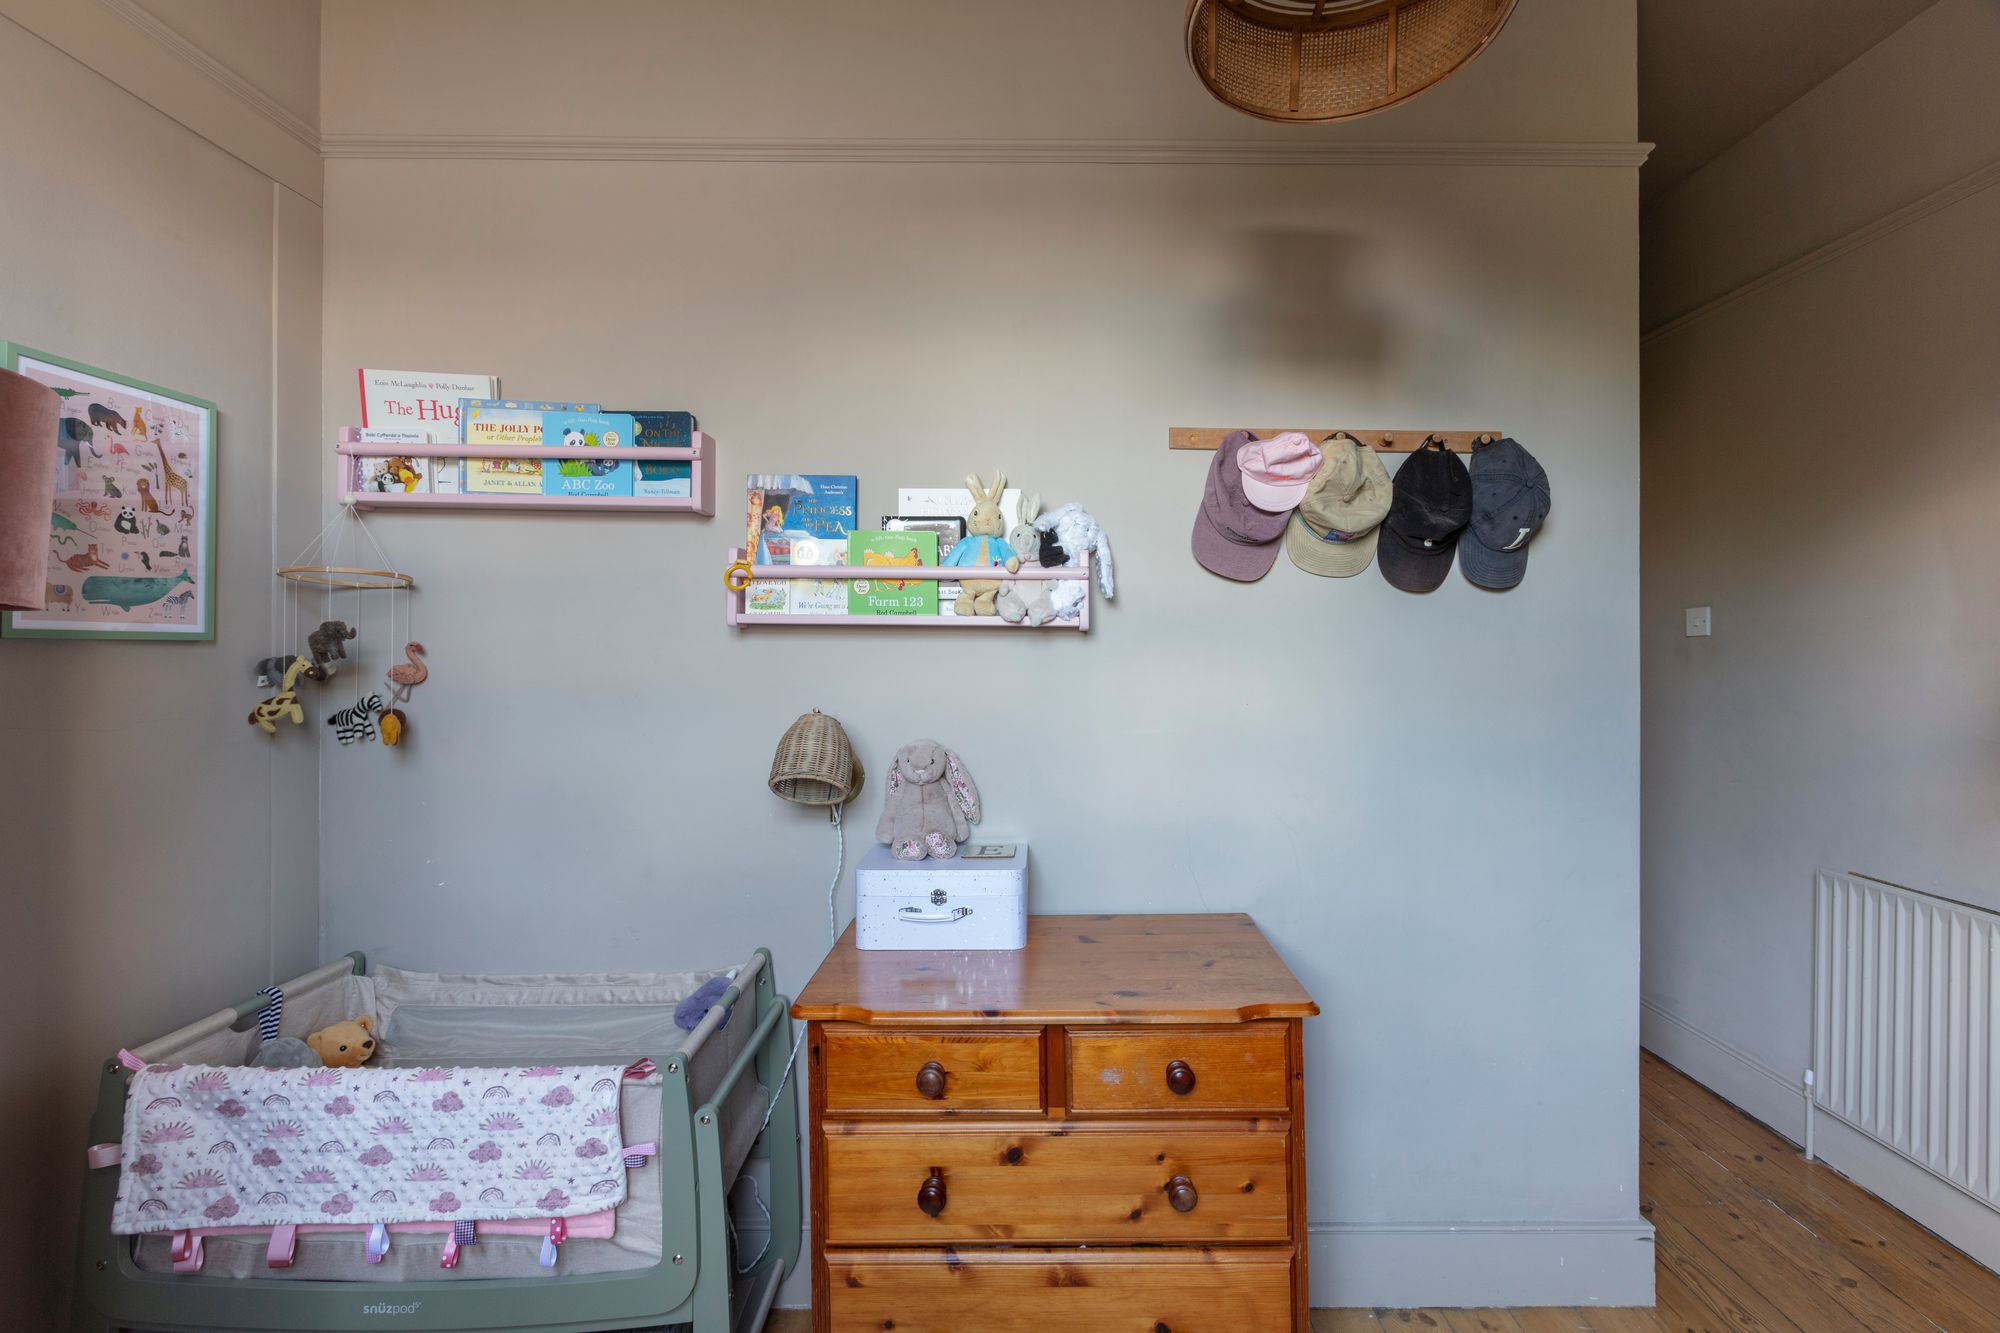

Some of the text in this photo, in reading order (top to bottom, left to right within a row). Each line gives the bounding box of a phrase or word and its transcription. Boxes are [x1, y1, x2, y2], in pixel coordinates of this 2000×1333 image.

[435, 383, 450, 392] Polly
[384, 400, 414, 416] The
[473, 423, 497, 432] THE
[499, 424, 529, 433] JOLLY
[561, 479, 615, 490] ABC Zoo
[868, 595, 924, 607] Farm 123
[976, 845, 1004, 855] E
